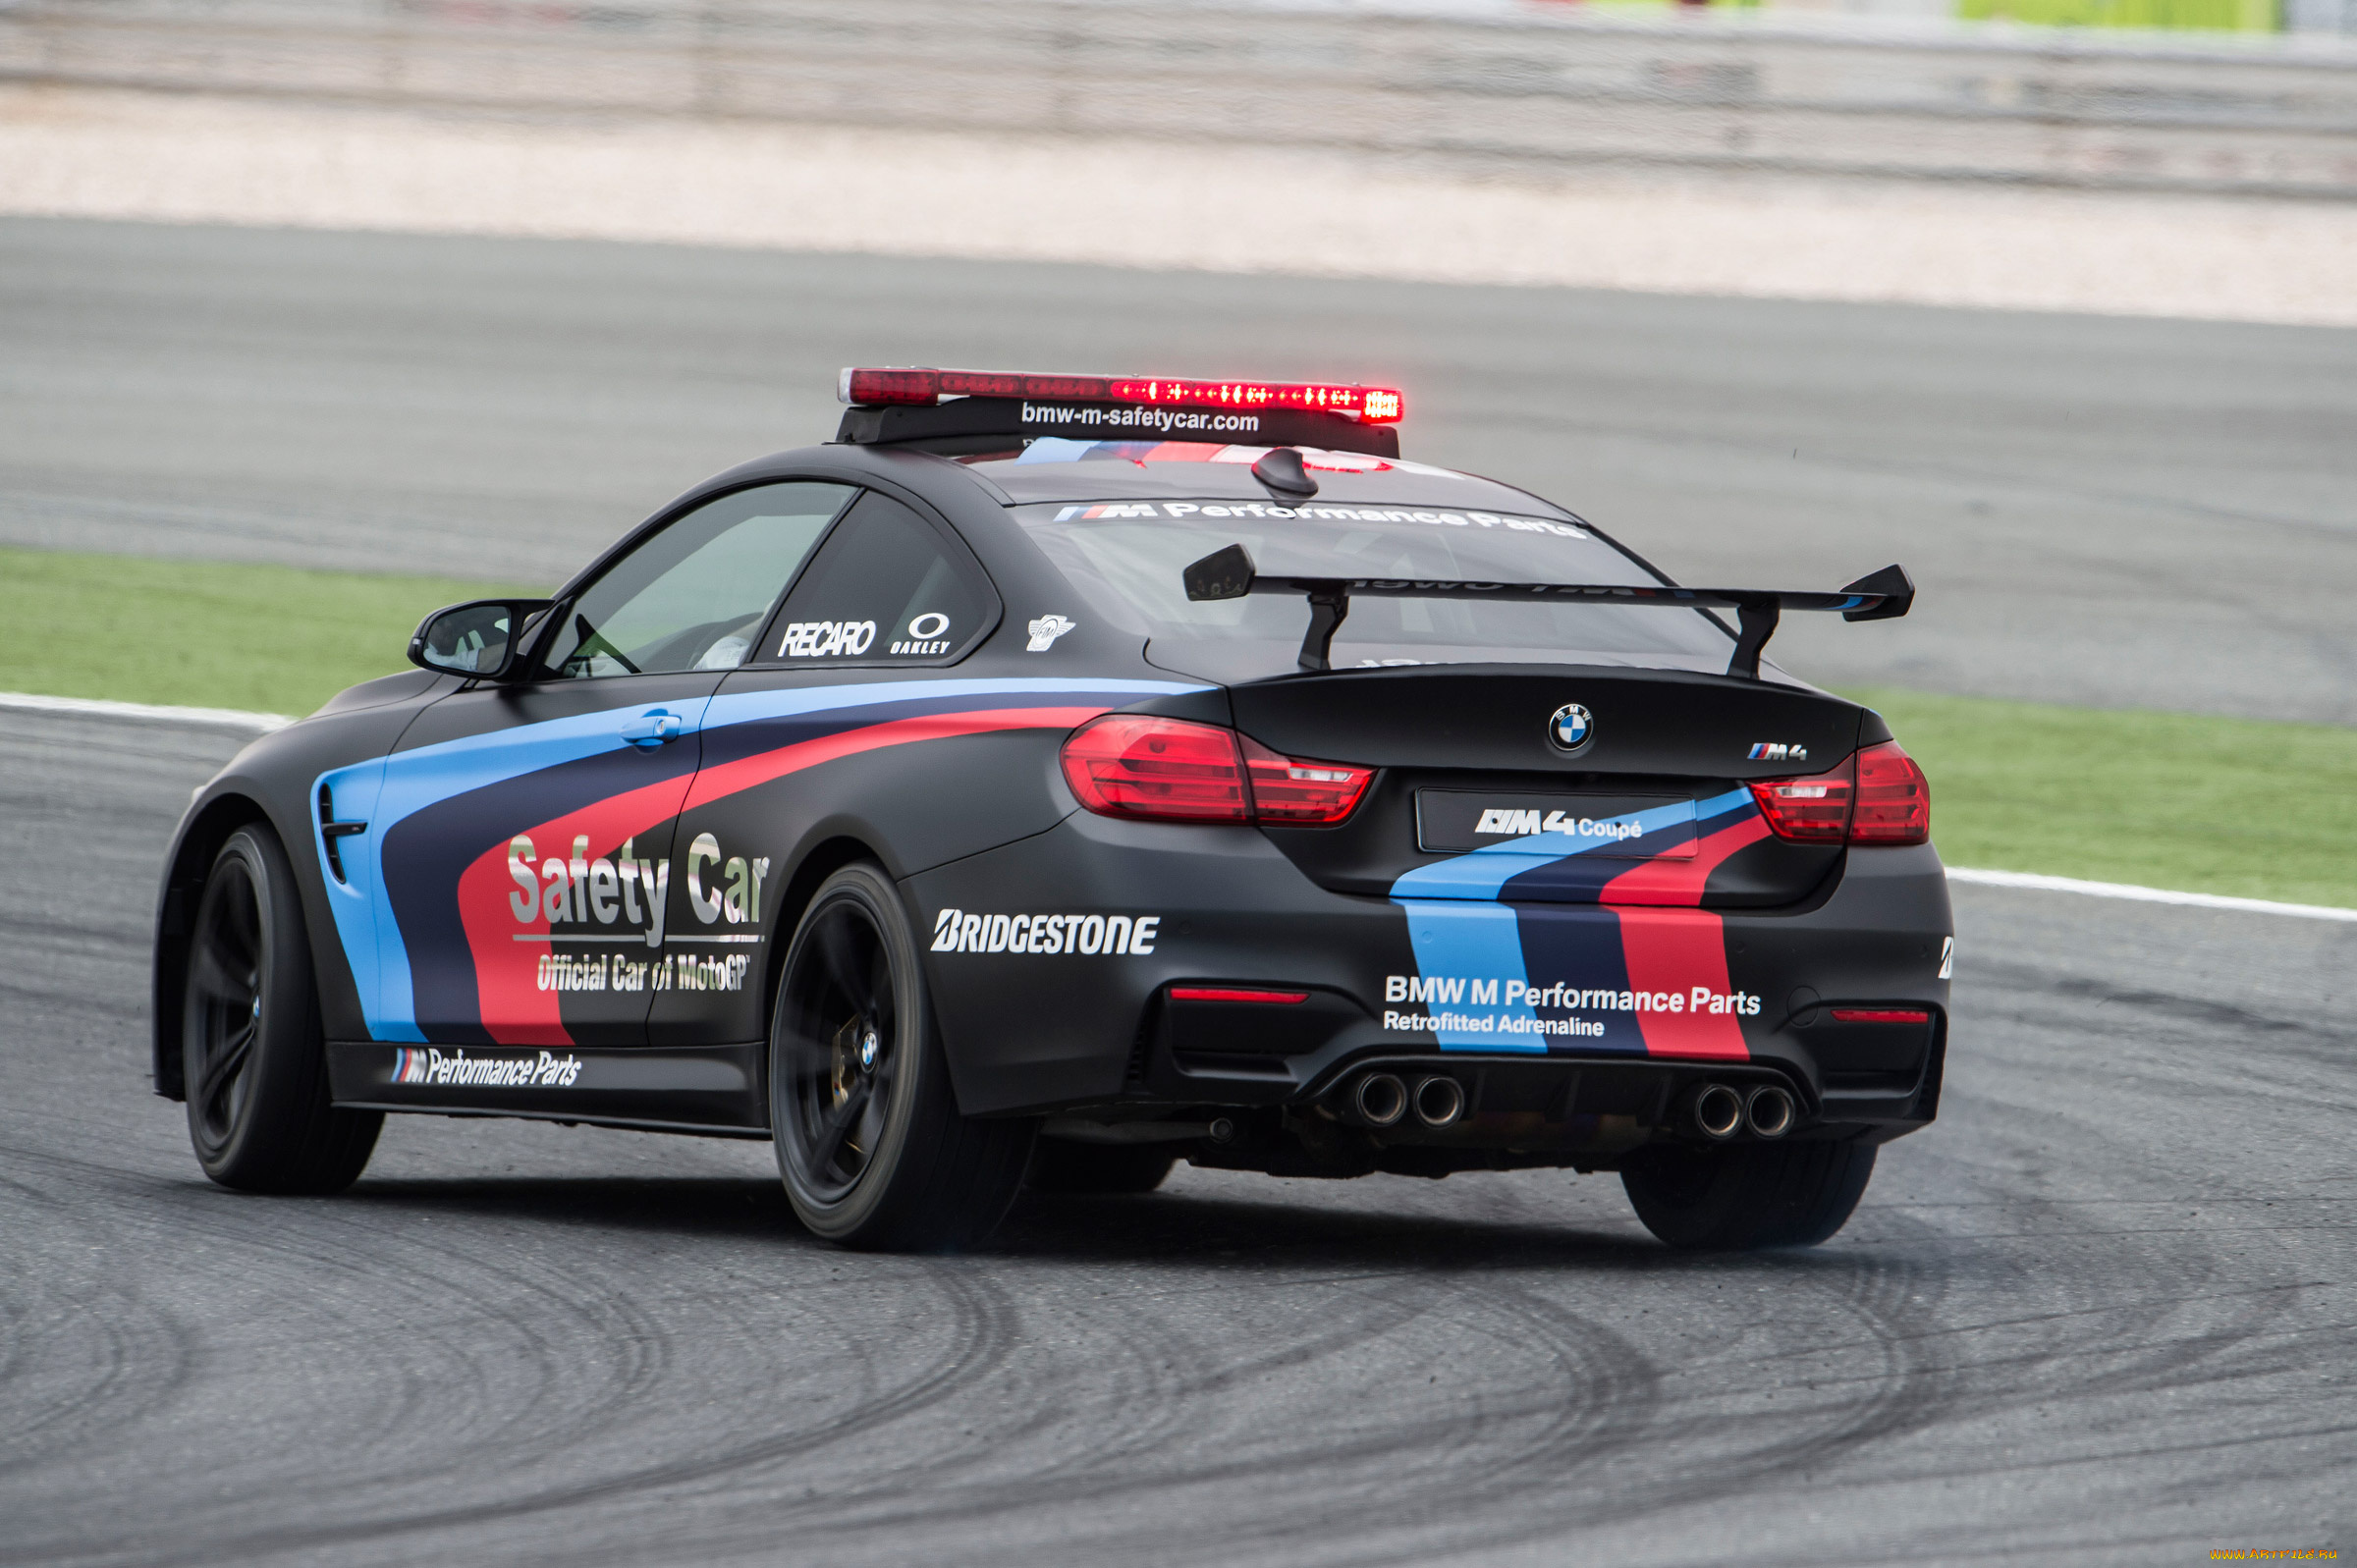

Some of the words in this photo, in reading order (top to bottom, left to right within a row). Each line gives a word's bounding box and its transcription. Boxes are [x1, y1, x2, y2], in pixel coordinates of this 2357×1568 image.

[1021, 402, 1259, 431] bmw-m-safetycar.com
[1163, 503, 1469, 526] Performance
[1467, 512, 1587, 540] Parts
[777, 621, 877, 657] RECARO
[890, 641, 951, 655] OAKLEY
[1555, 705, 1592, 722] BMW
[1578, 818, 1642, 841] Coupé
[508, 835, 670, 948] Safety
[687, 832, 771, 925] Car
[930, 908, 1161, 955] BRIDGESTONE
[537, 954, 607, 991] Official
[612, 953, 647, 991] Car
[652, 954, 673, 991] of
[1386, 976, 1466, 1003] BMW
[1471, 979, 1499, 1005] M
[1505, 980, 1685, 1012] Performance
[1690, 987, 1761, 1015] Parts
[1384, 1010, 1495, 1032] Retrofitted
[1498, 1014, 1605, 1037] Adrenaline
[425, 1048, 534, 1085] Performance
[531, 1051, 582, 1086] Parts
